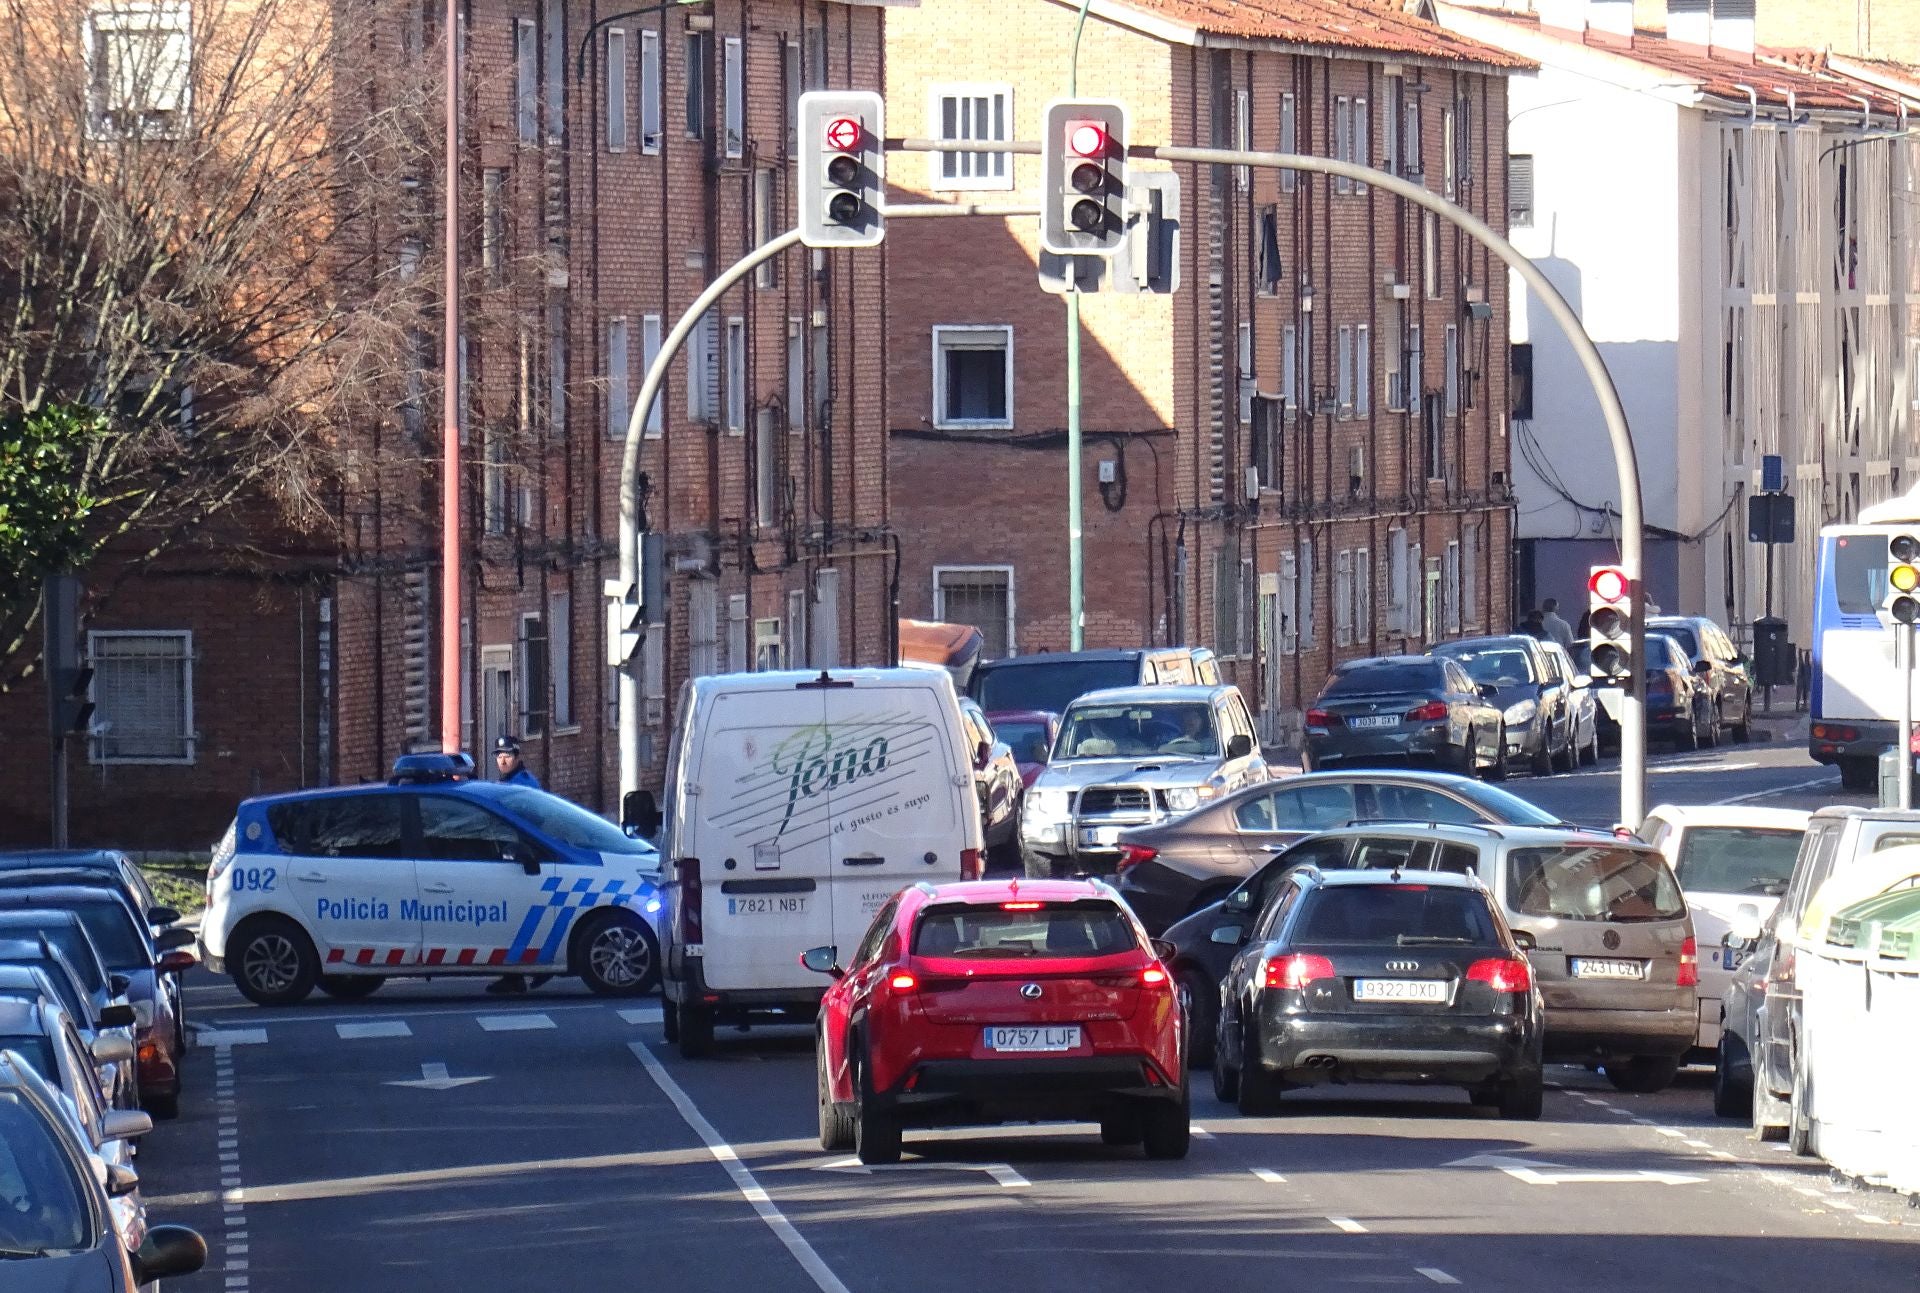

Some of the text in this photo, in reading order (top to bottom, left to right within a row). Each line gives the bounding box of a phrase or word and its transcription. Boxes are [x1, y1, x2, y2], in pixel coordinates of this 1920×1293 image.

[834, 793, 930, 834] el gusto es suyo
[231, 867, 277, 892] 092
[400, 899, 508, 926] Municipal
[738, 898, 807, 913] 7821 NBT
[1582, 960, 1612, 974] 2431
[1366, 982, 1437, 998] 9322 DXD
[997, 1029, 1077, 1045] 0757 LJF
